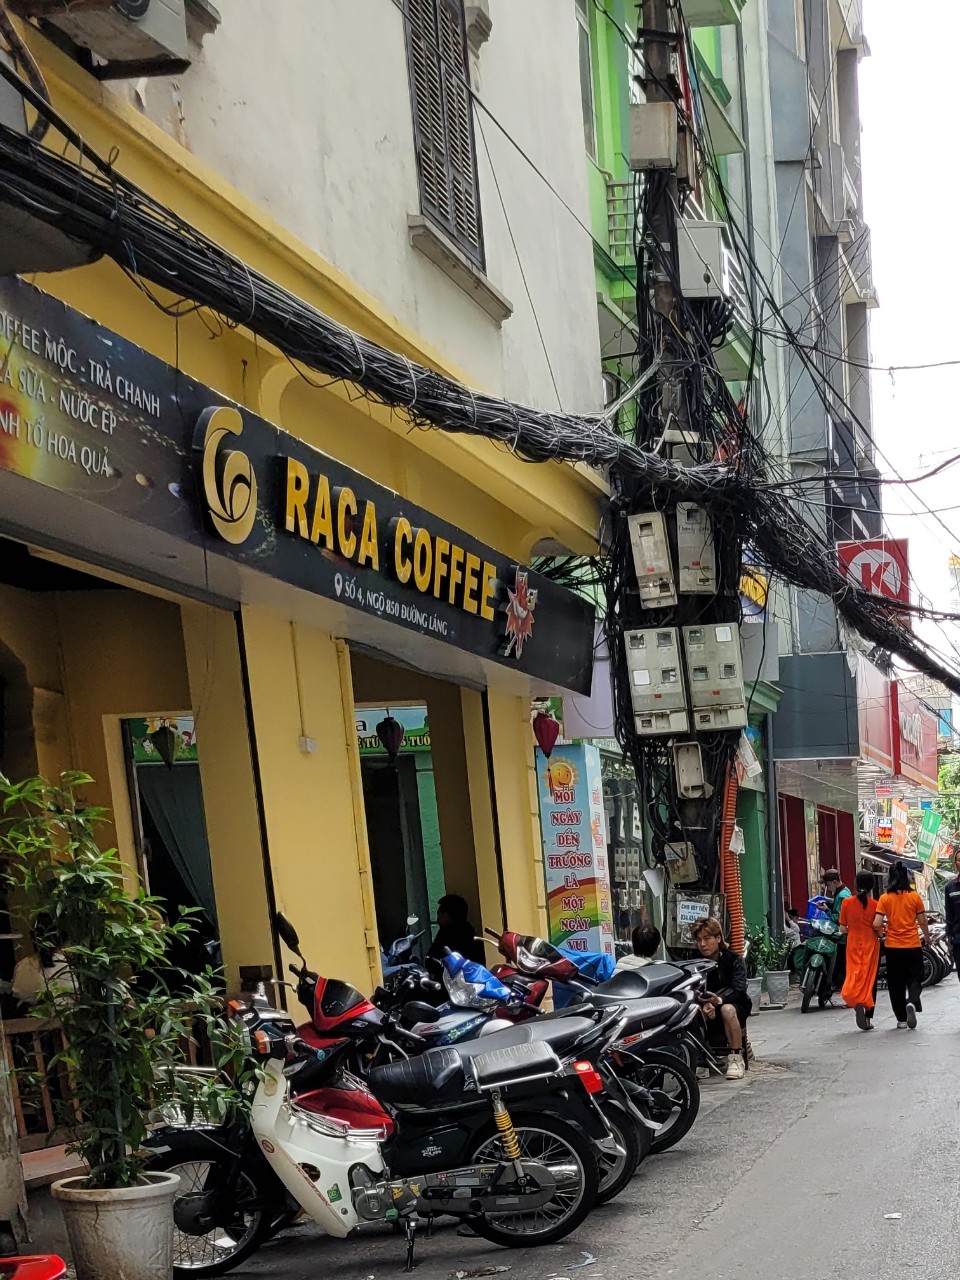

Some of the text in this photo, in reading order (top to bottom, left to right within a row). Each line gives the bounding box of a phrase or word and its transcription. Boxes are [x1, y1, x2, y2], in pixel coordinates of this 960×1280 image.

[44, 329, 77, 374] MỘC
[88, 358, 113, 393] TRÀ
[115, 375, 161, 418] CHANH
[59, 390, 98, 429] NƯỚC
[25, 416, 45, 448] TỐ
[47, 430, 77, 464] HOA
[80, 446, 109, 478] QUẢ
[285, 456, 497, 622] RACA COFFEE
[861, 561, 897, 595] K
[344, 577, 357, 599] SỐ
[366, 589, 385, 611] NGÕ
[386, 598, 400, 617] 850
[401, 604, 428, 628] ĐƯỜNG
[428, 614, 448, 636] LÁNG
[551, 809, 582, 827] NGÀY
[556, 828, 580, 848] ĐẾN
[548, 851, 592, 869] TRƯỜNG
[564, 875, 579, 889] LÀ
[562, 891, 585, 912] MỘT
[559, 913, 591, 932] NGÀY
[567, 939, 588, 952] VUI
